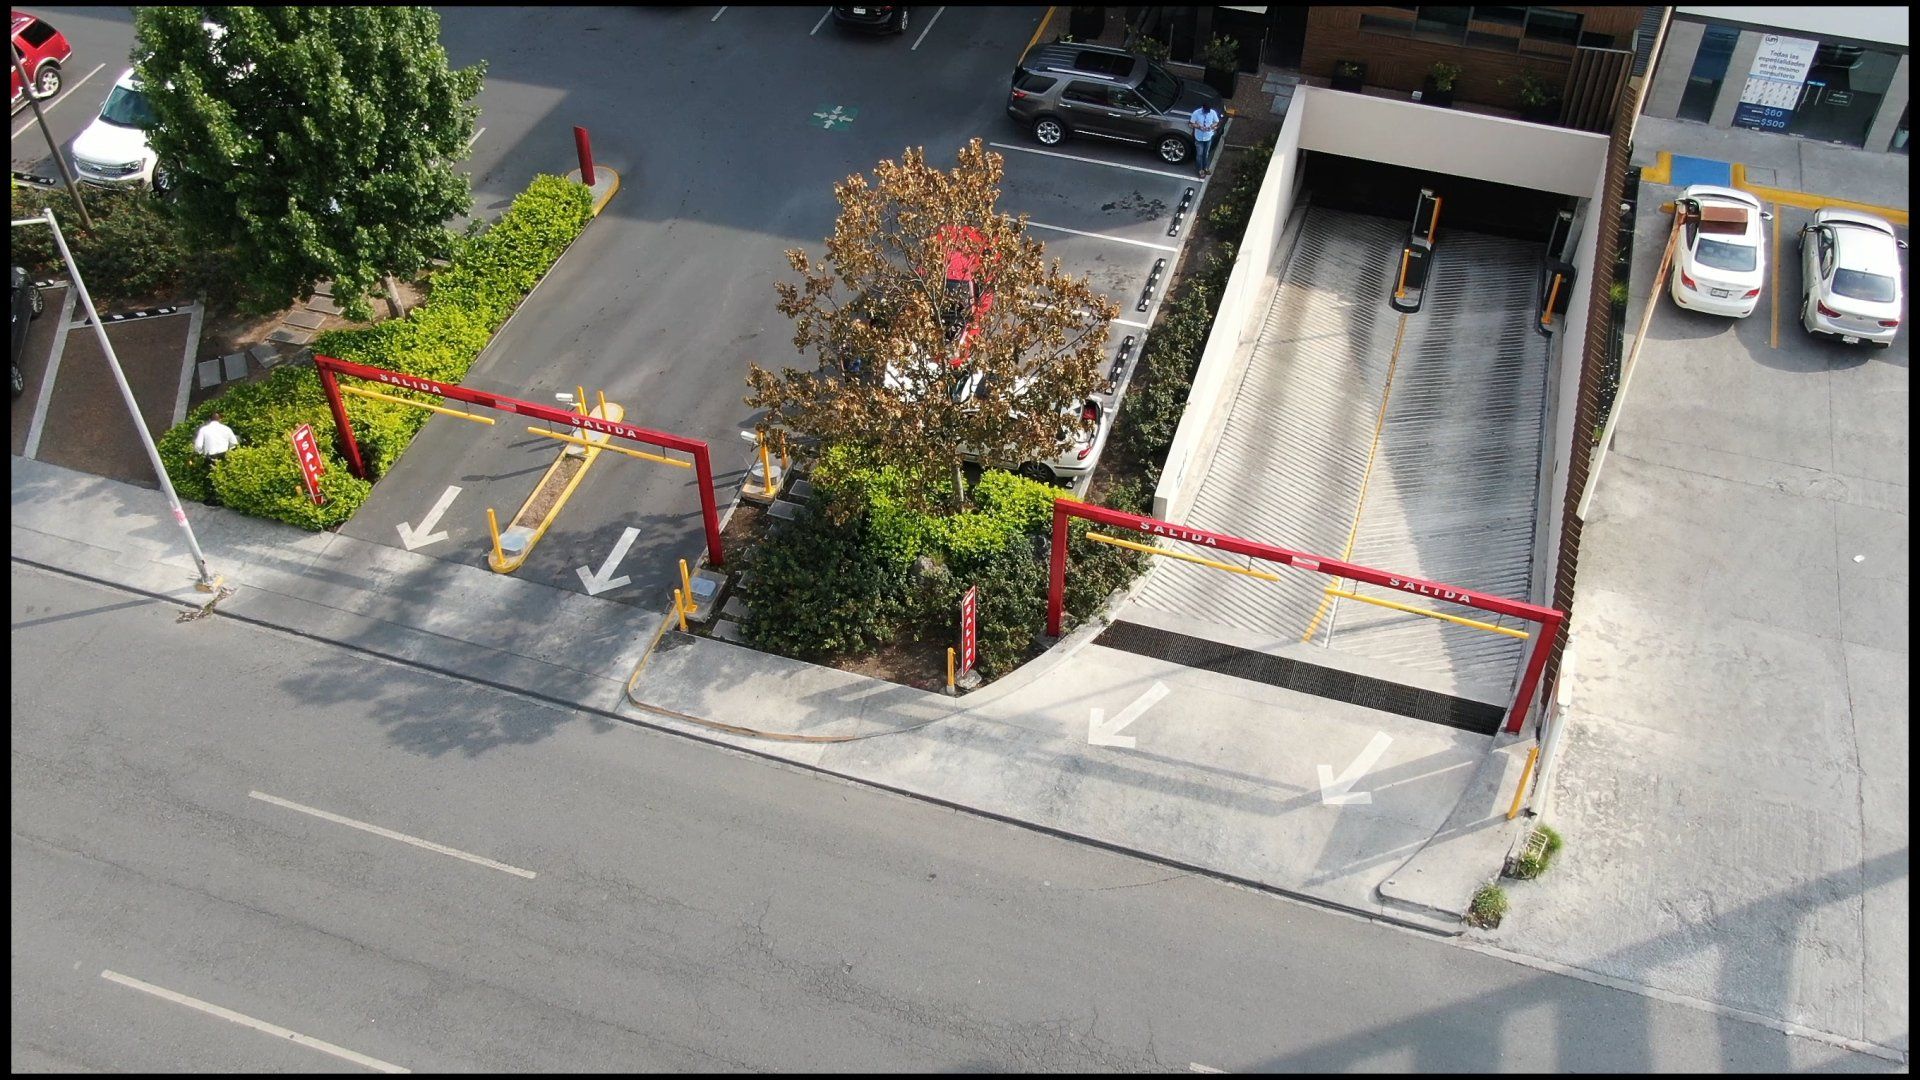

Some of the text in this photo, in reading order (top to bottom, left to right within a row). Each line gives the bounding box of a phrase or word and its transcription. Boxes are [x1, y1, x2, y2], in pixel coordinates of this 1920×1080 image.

[1760, 118, 1785, 128] $500
[1764, 108, 1783, 117] $60
[380, 373, 442, 395] SALIDA
[571, 417, 637, 439] SALIDA
[1140, 521, 1218, 546] SALIDA
[1388, 577, 1472, 604] SALIDA
